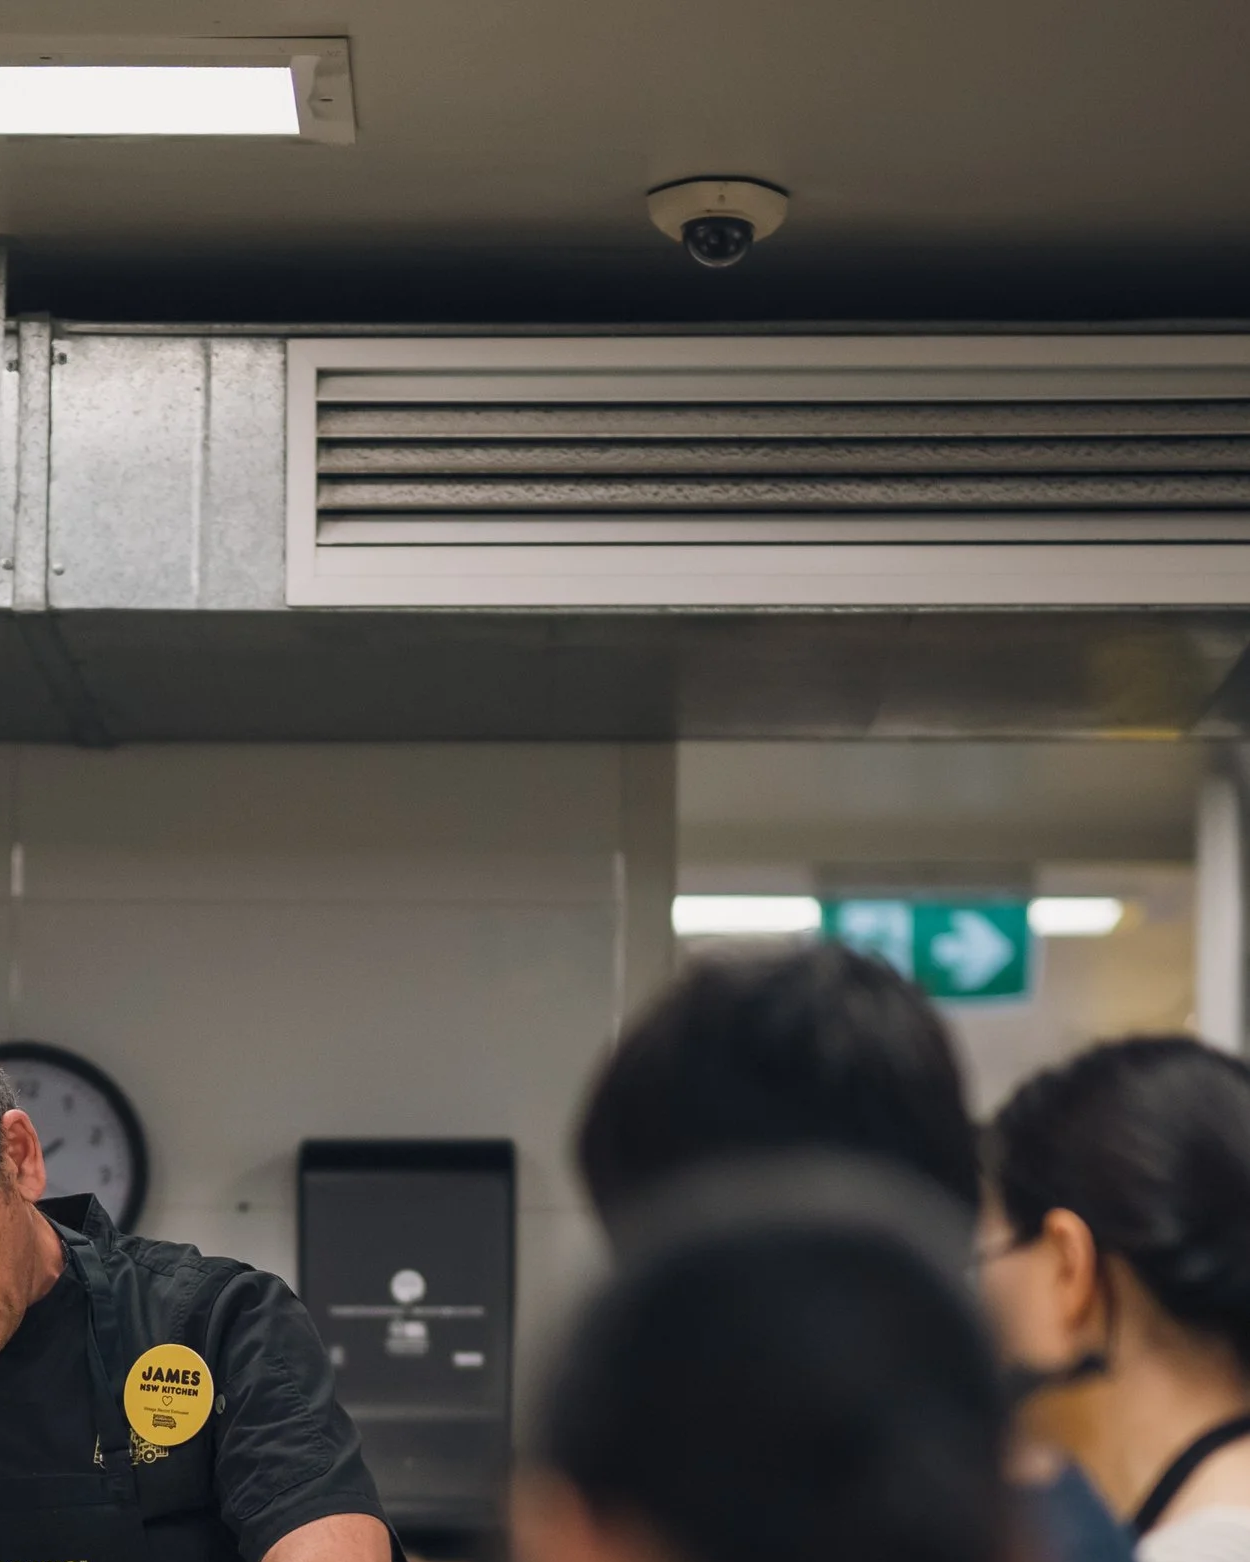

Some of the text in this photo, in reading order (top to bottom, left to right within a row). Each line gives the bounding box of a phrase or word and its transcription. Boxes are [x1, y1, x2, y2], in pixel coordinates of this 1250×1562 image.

[142, 1366, 200, 1386] JAMES
[140, 1383, 198, 1397] NSW KITCHEN
